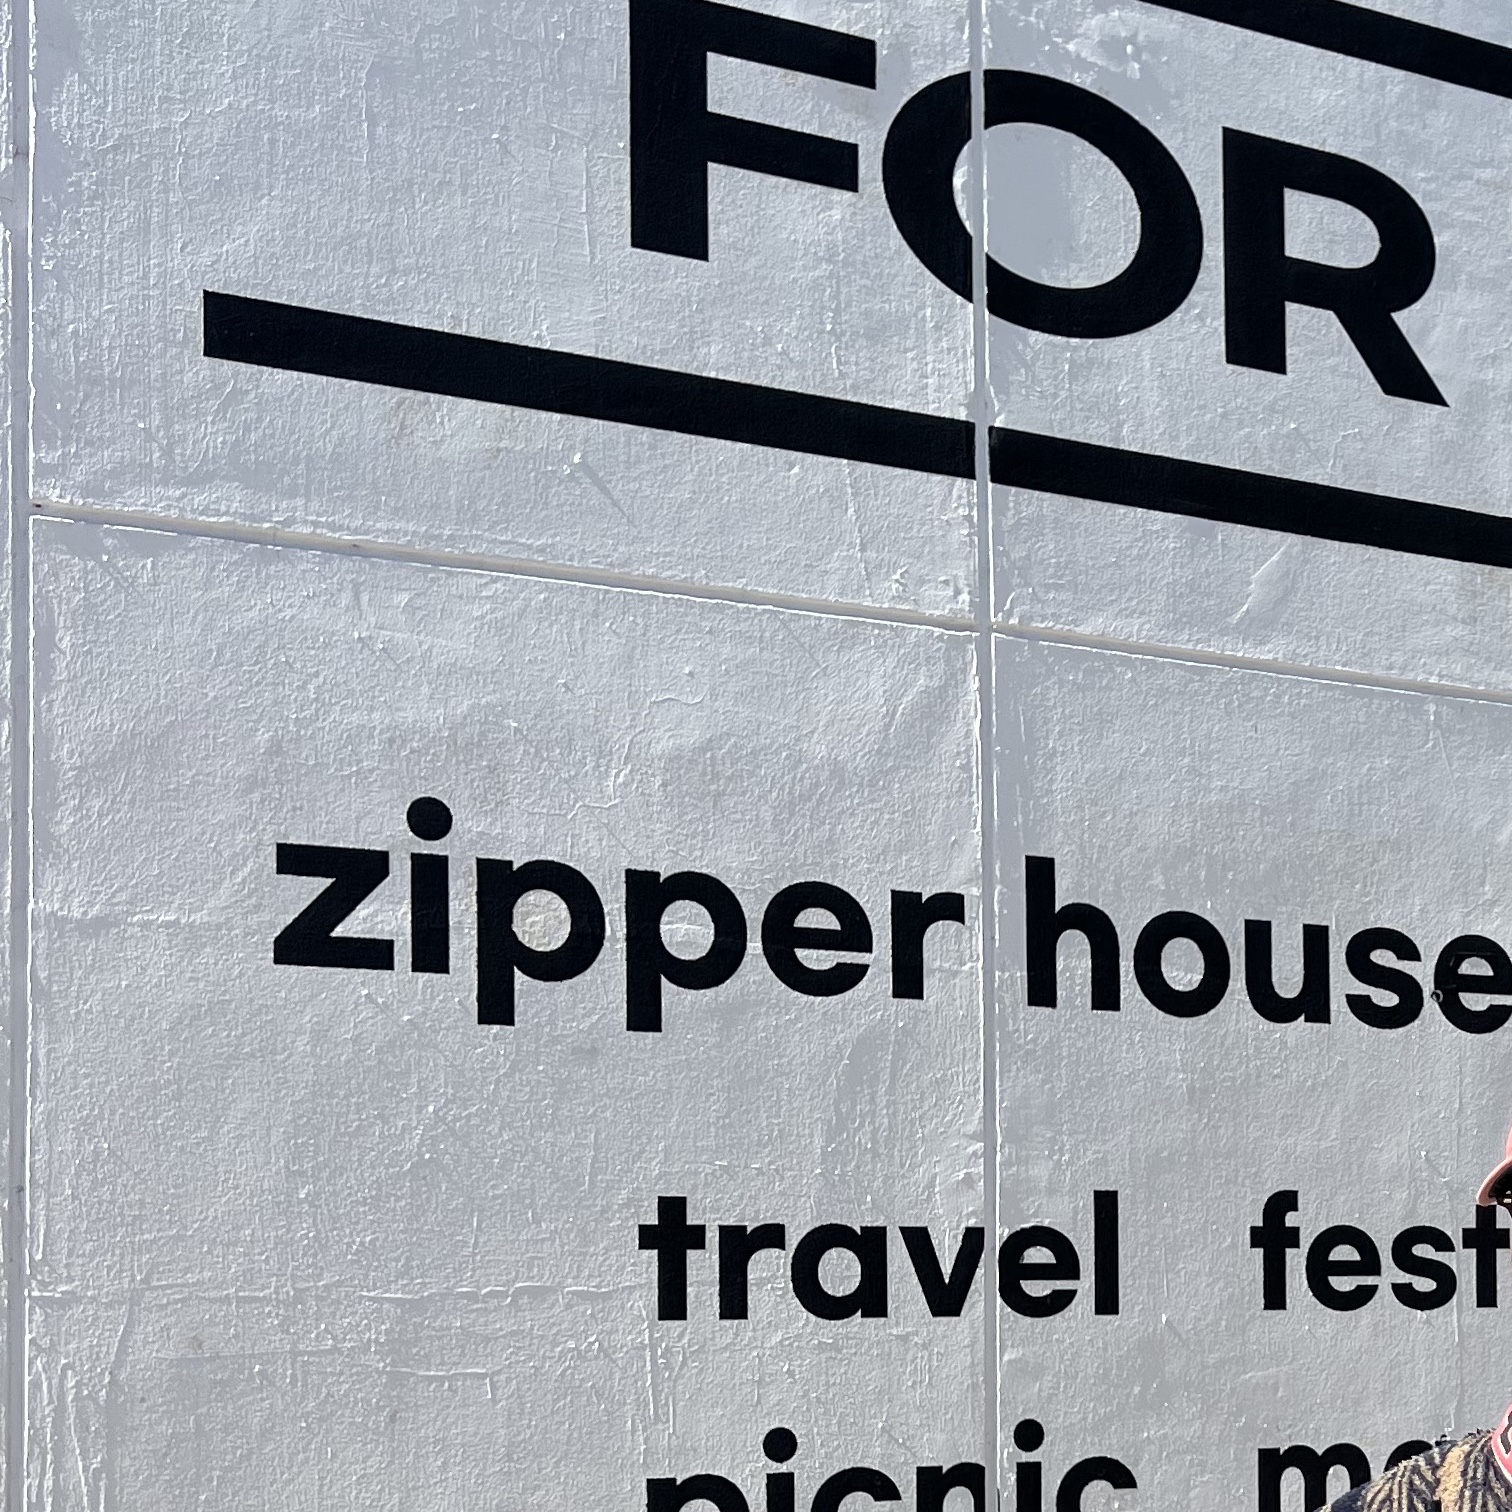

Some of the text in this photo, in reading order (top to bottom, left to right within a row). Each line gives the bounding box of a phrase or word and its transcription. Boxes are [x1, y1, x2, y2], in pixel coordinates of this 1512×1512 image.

[629, 0, 1449, 407] FOR
[274, 797, 966, 1033] zipper
[637, 1190, 1120, 1322] travel
